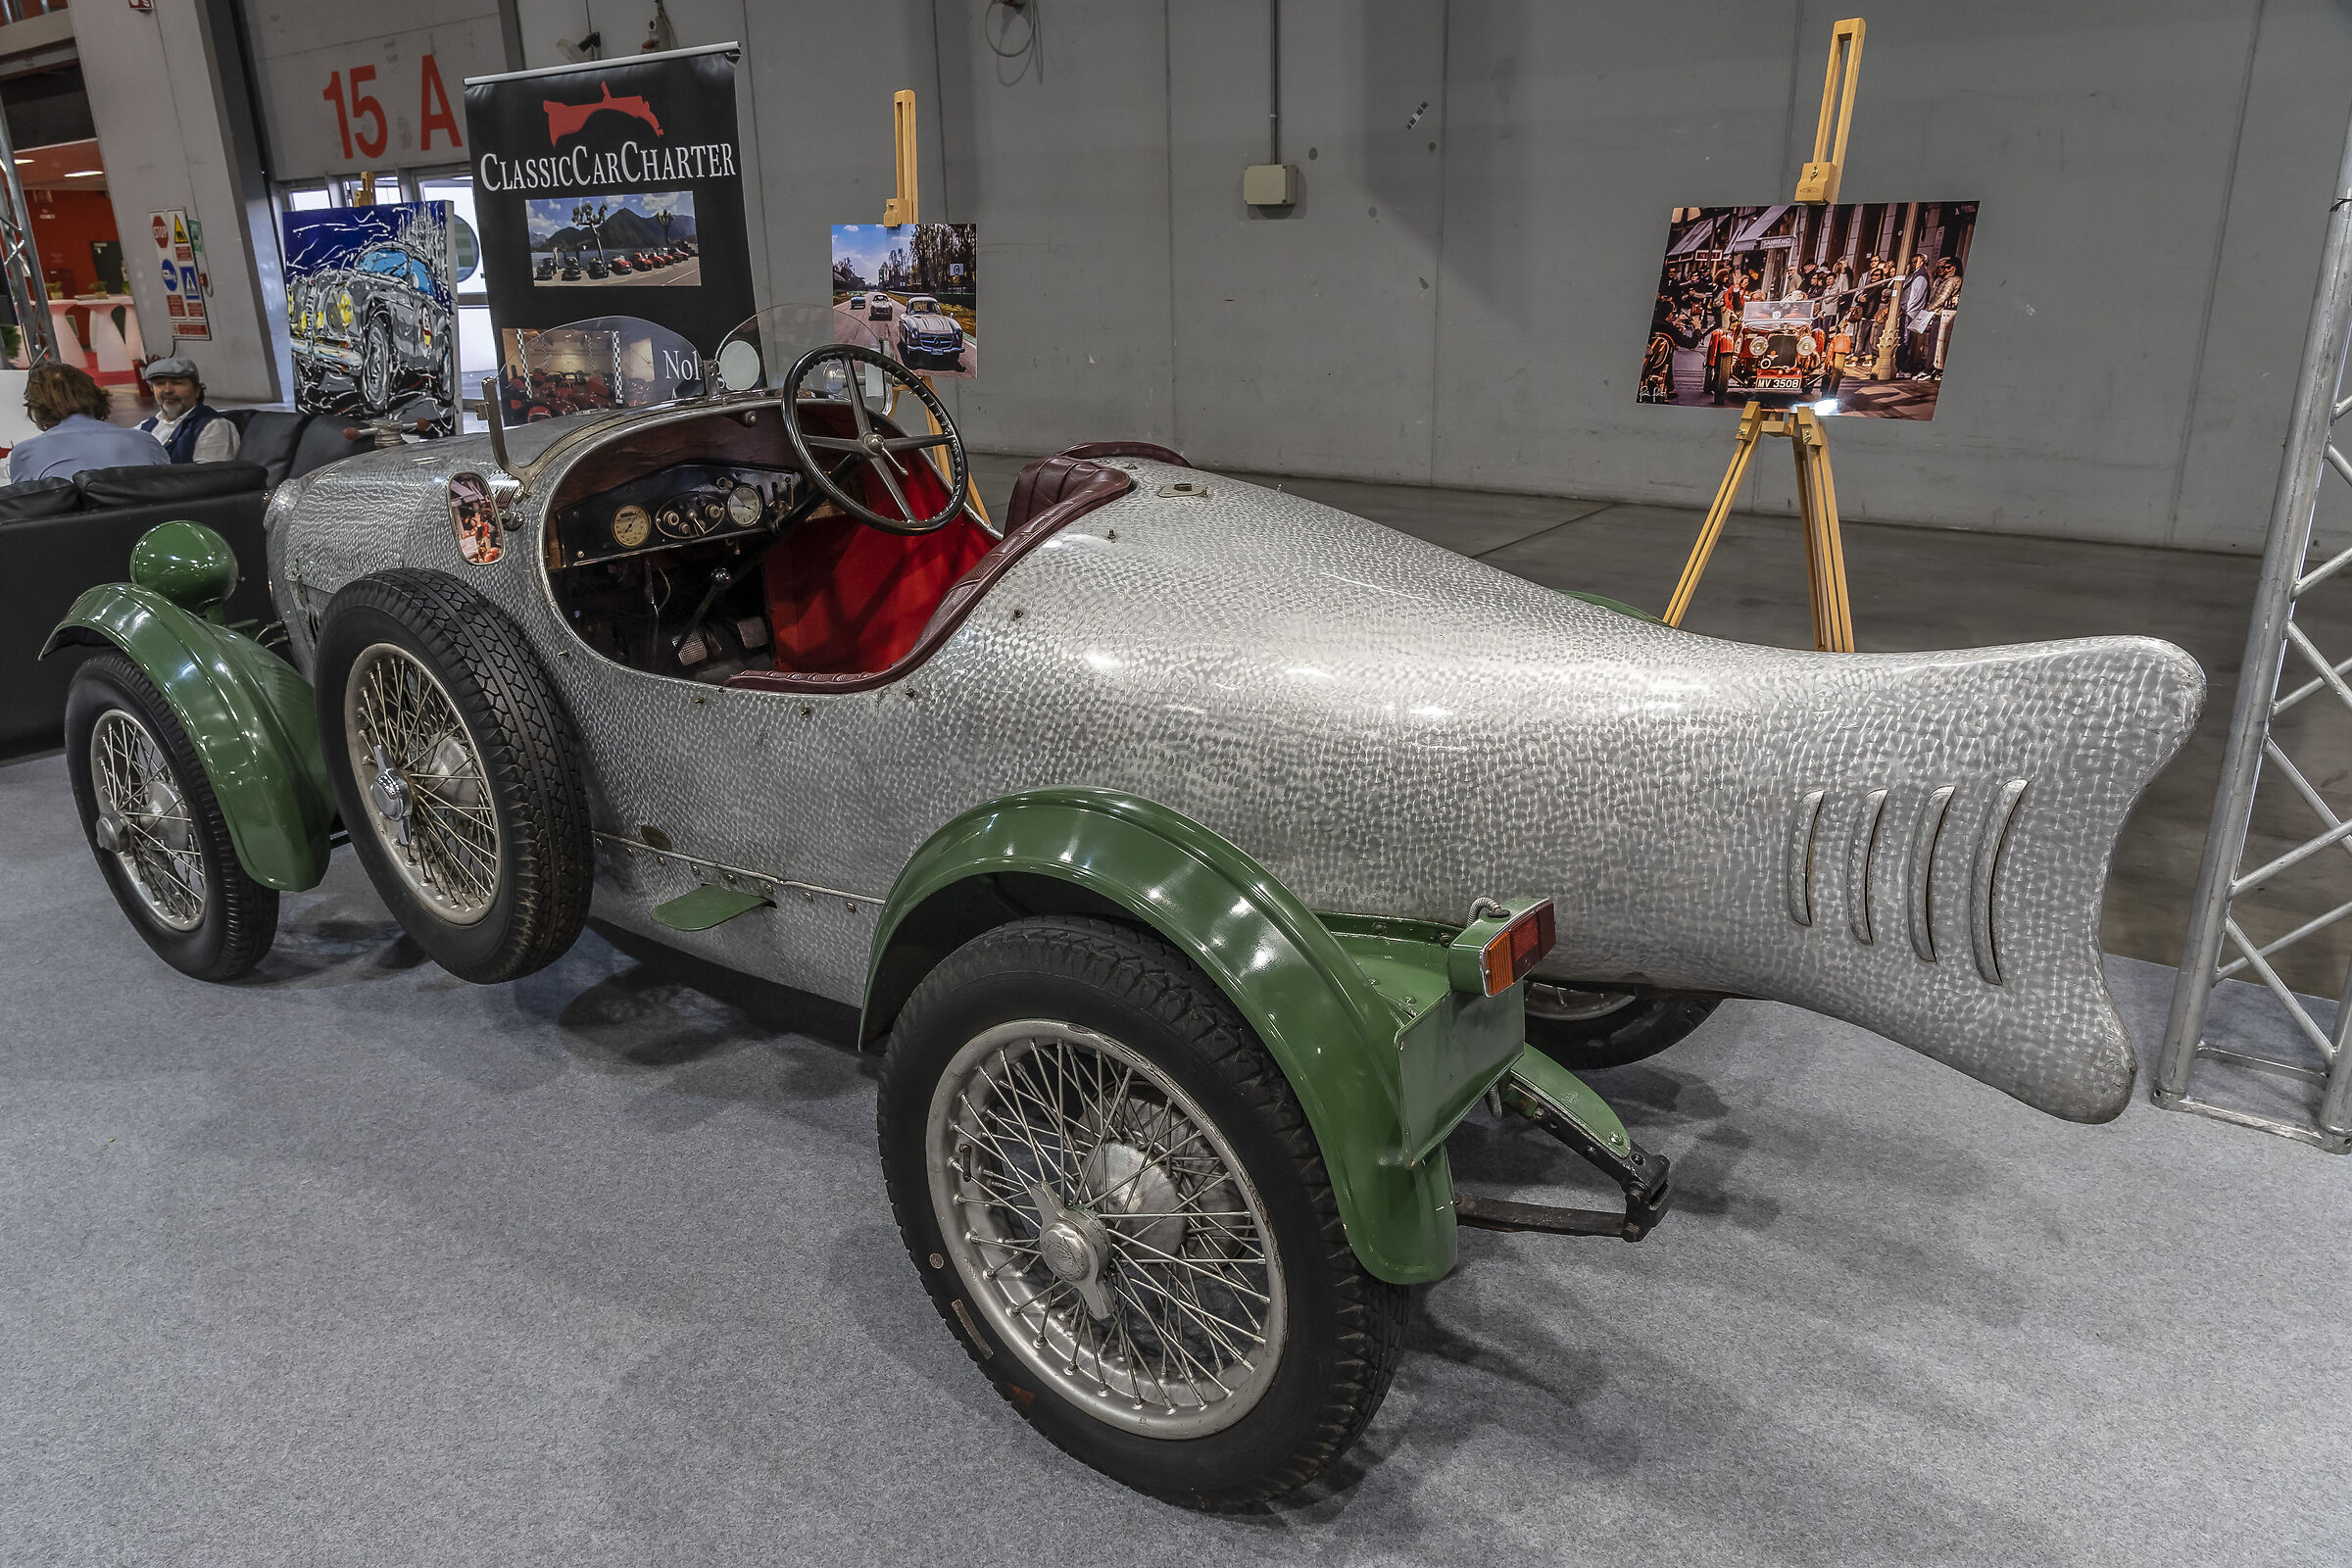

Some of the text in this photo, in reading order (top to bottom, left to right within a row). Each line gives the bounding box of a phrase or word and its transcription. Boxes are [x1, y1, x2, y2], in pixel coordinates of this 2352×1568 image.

[322, 54, 464, 160] 15 A
[1757, 378, 1799, 388] MV 3508
